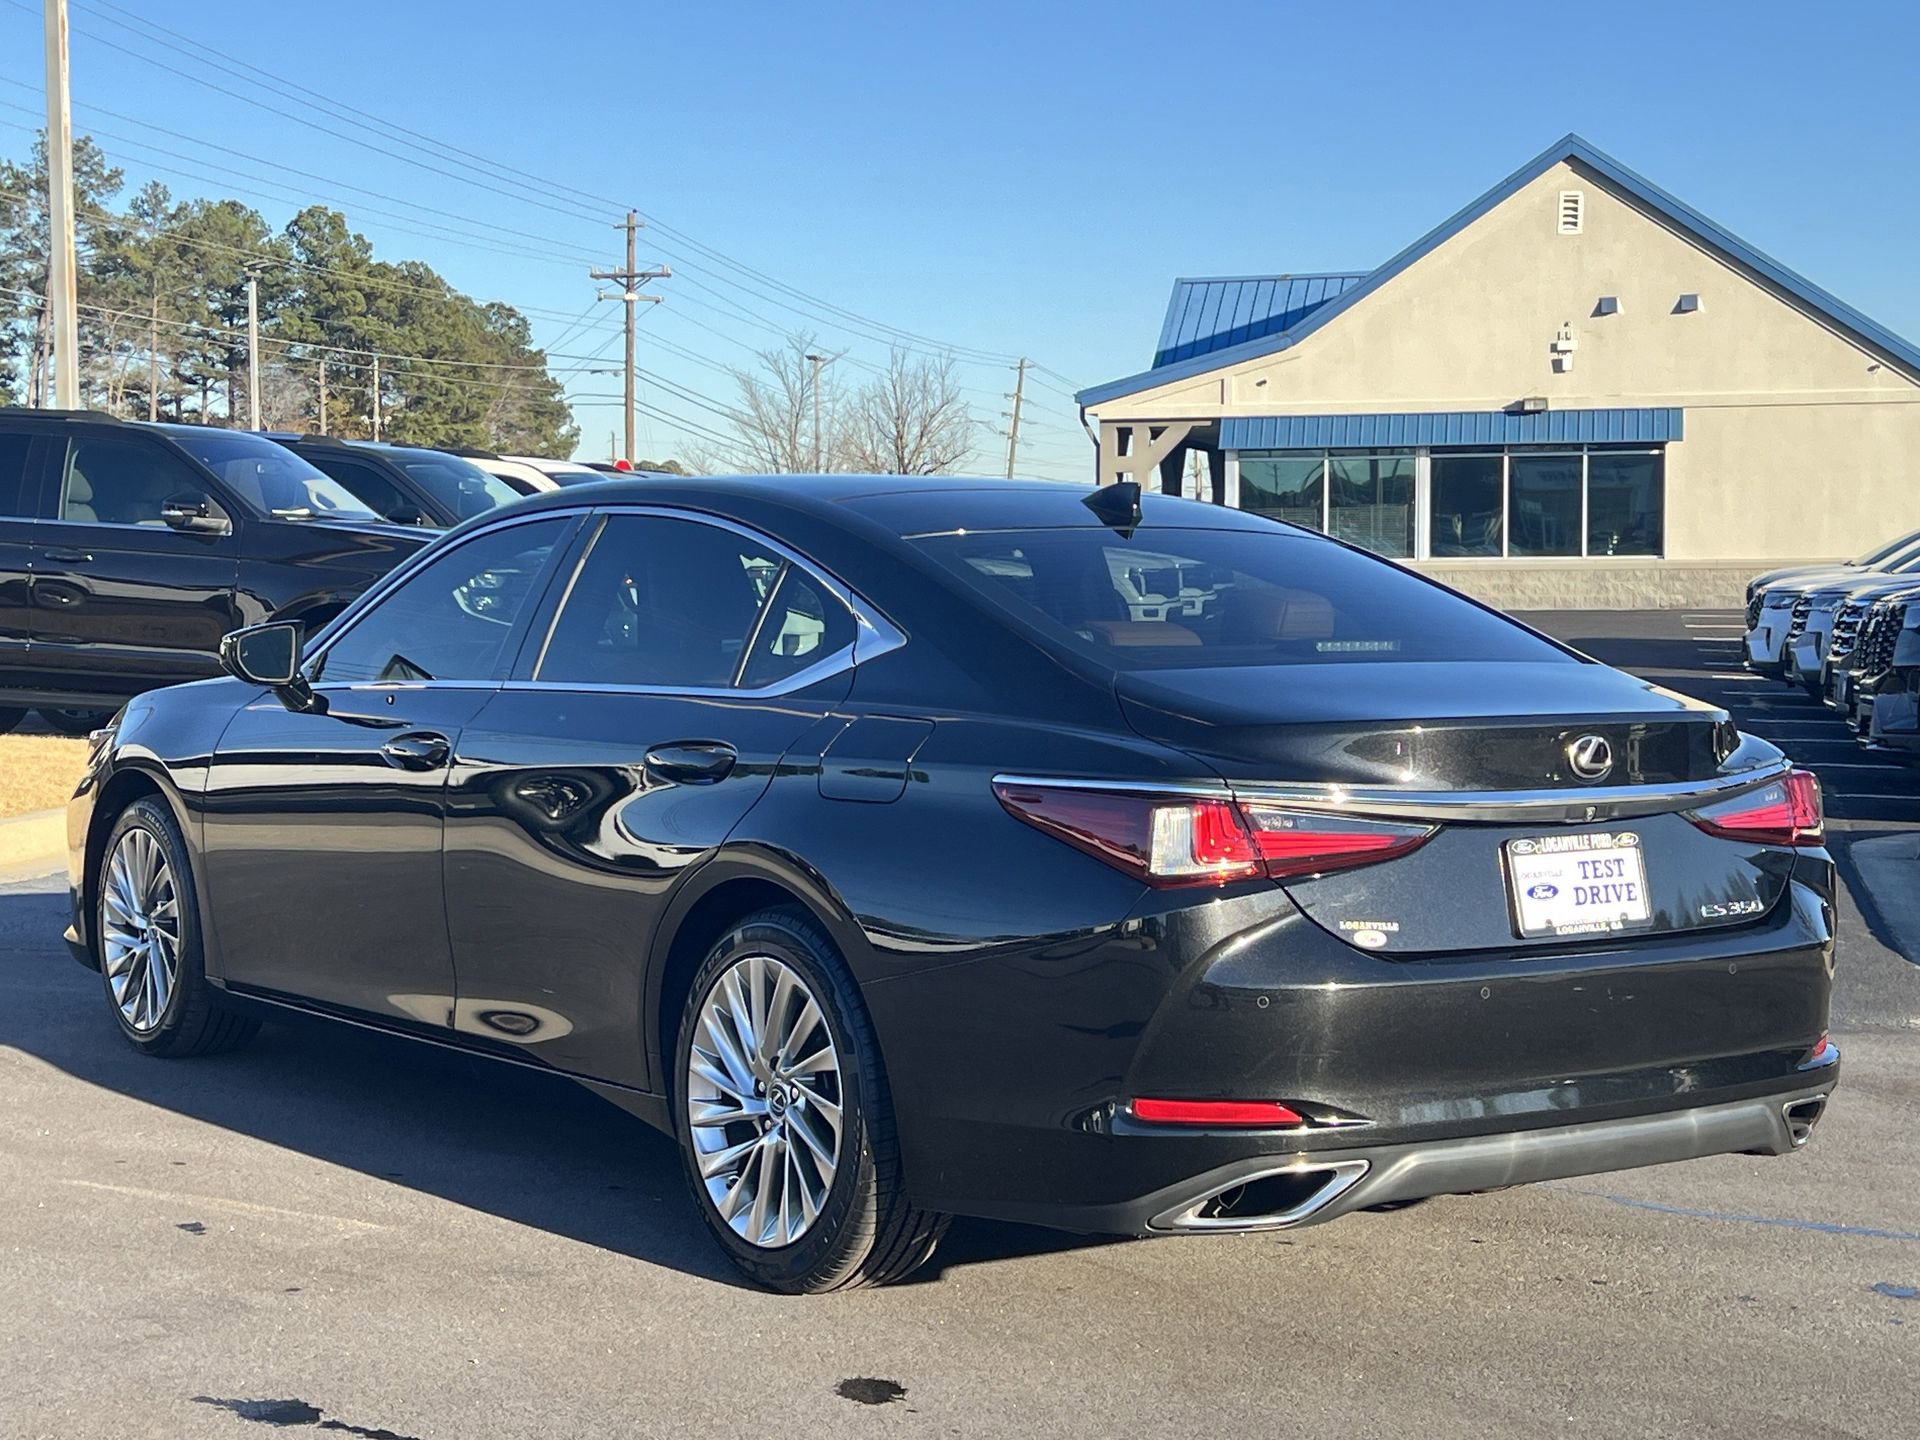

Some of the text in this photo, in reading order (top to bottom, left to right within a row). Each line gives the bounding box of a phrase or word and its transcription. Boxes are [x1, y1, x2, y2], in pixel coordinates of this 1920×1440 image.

[1540, 834, 1589, 852] LOGANVILLE
[1518, 869, 1563, 882] OGANVILLE
[1577, 858, 1625, 880] TEST
[1573, 882, 1638, 906] DRIVE
[1339, 920, 1399, 932] LOGANVILLE
